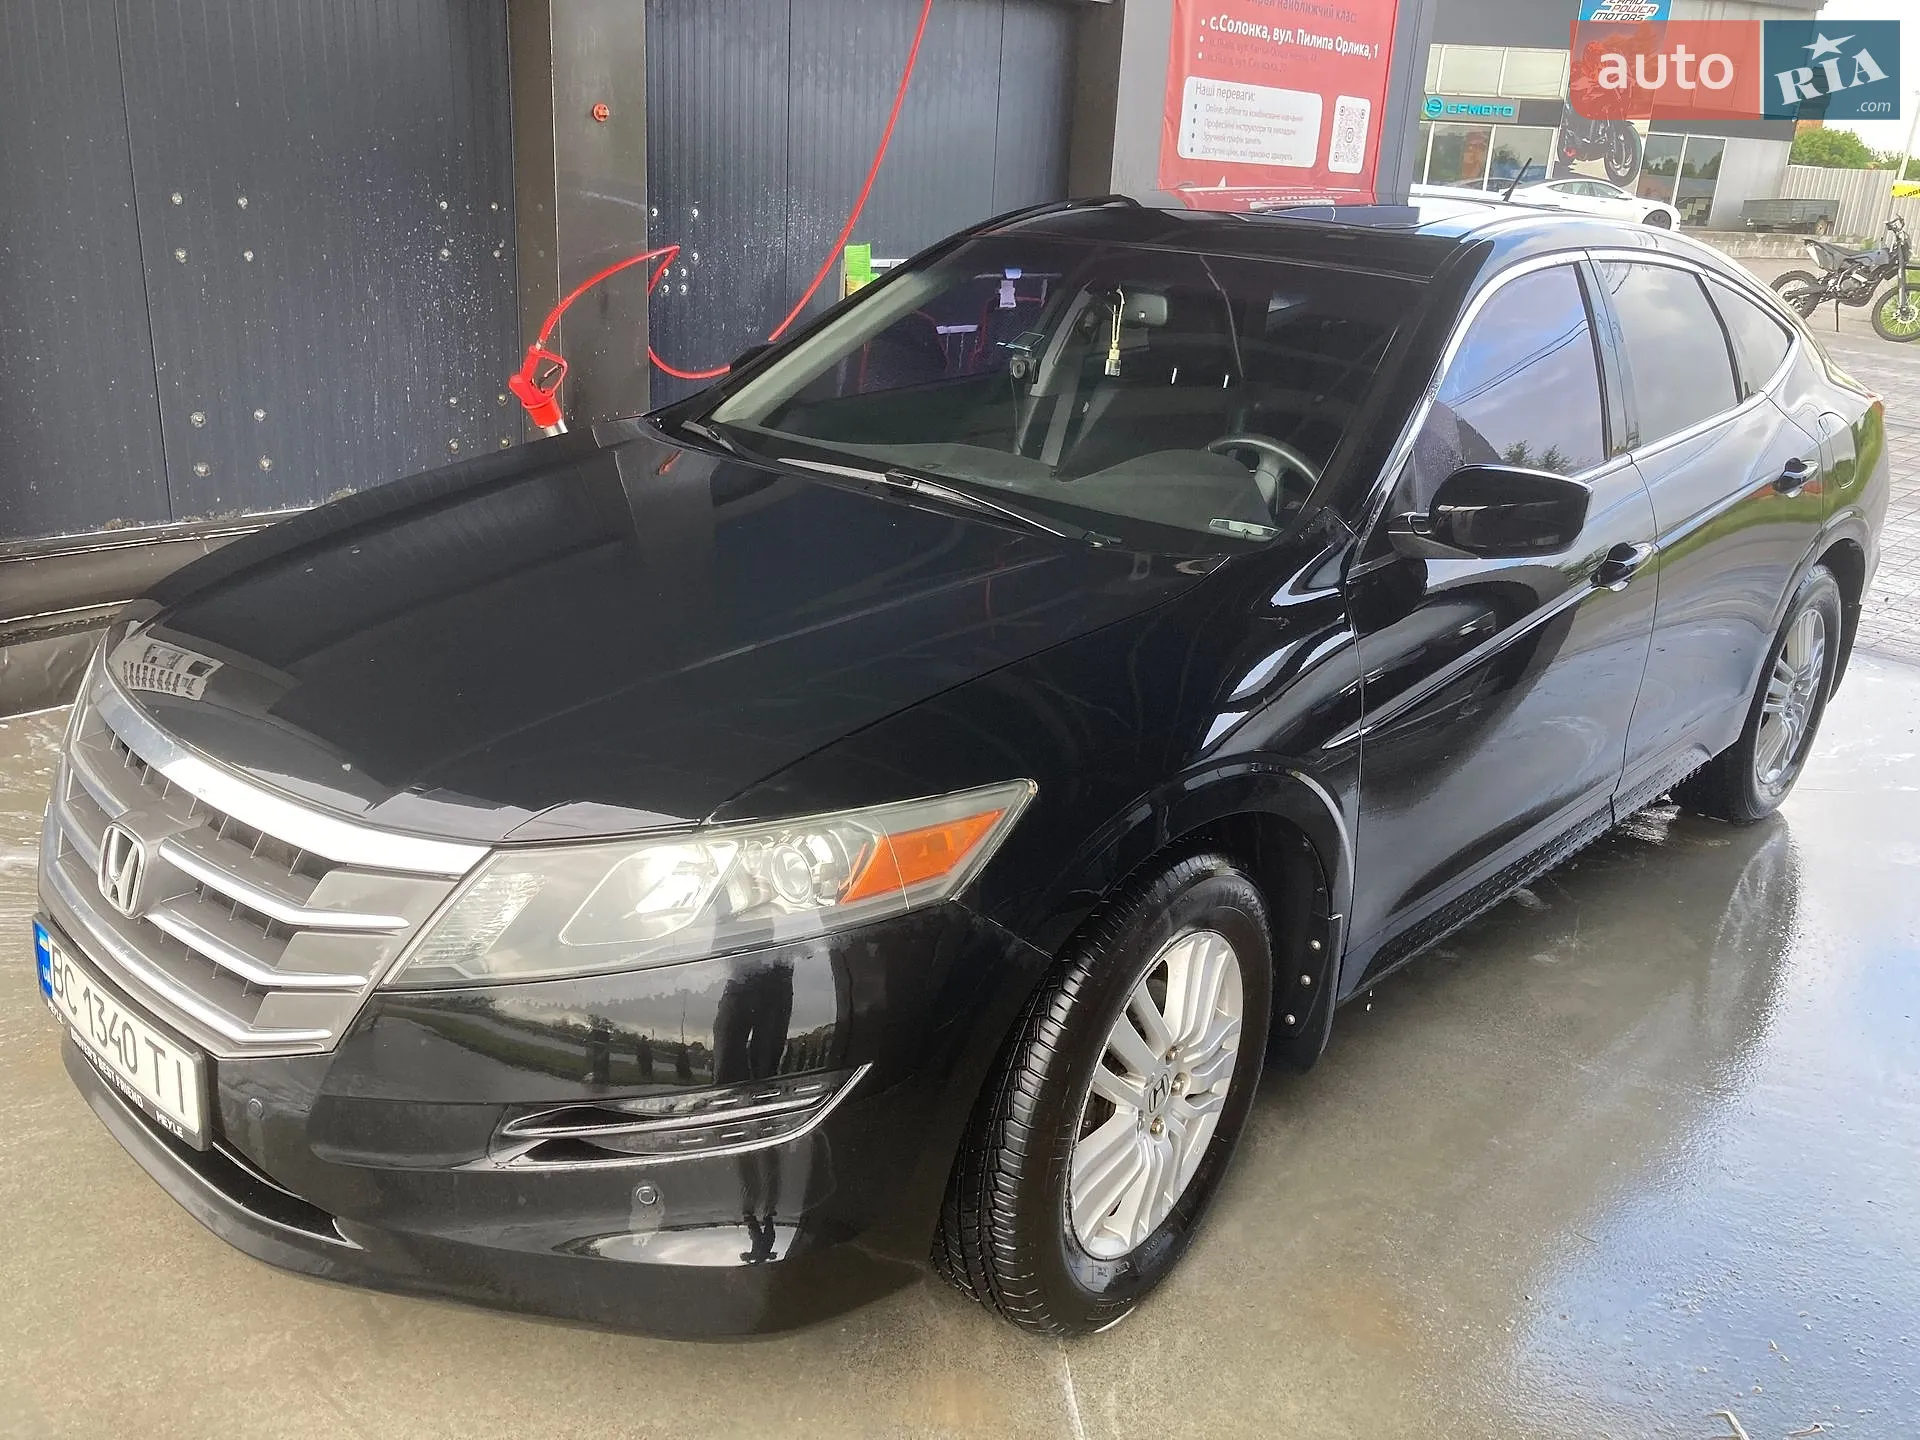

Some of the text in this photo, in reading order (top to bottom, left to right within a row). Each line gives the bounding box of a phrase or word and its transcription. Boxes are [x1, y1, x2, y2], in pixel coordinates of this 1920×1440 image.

[1592, 12, 1645, 21] MOTORS
[1611, 4, 1657, 14] POWER
[1209, 14, 1271, 43] с.Солонка,
[1272, 26, 1295, 45] вул.
[1296, 29, 1334, 50] Пилипа
[1335, 36, 1372, 60] Орлика,
[1374, 43, 1380, 59] 1
[1195, 81, 1215, 97] Наші
[1447, 103, 1515, 117] CFMOTO
[52, 944, 185, 1115] BC 1340 TI
